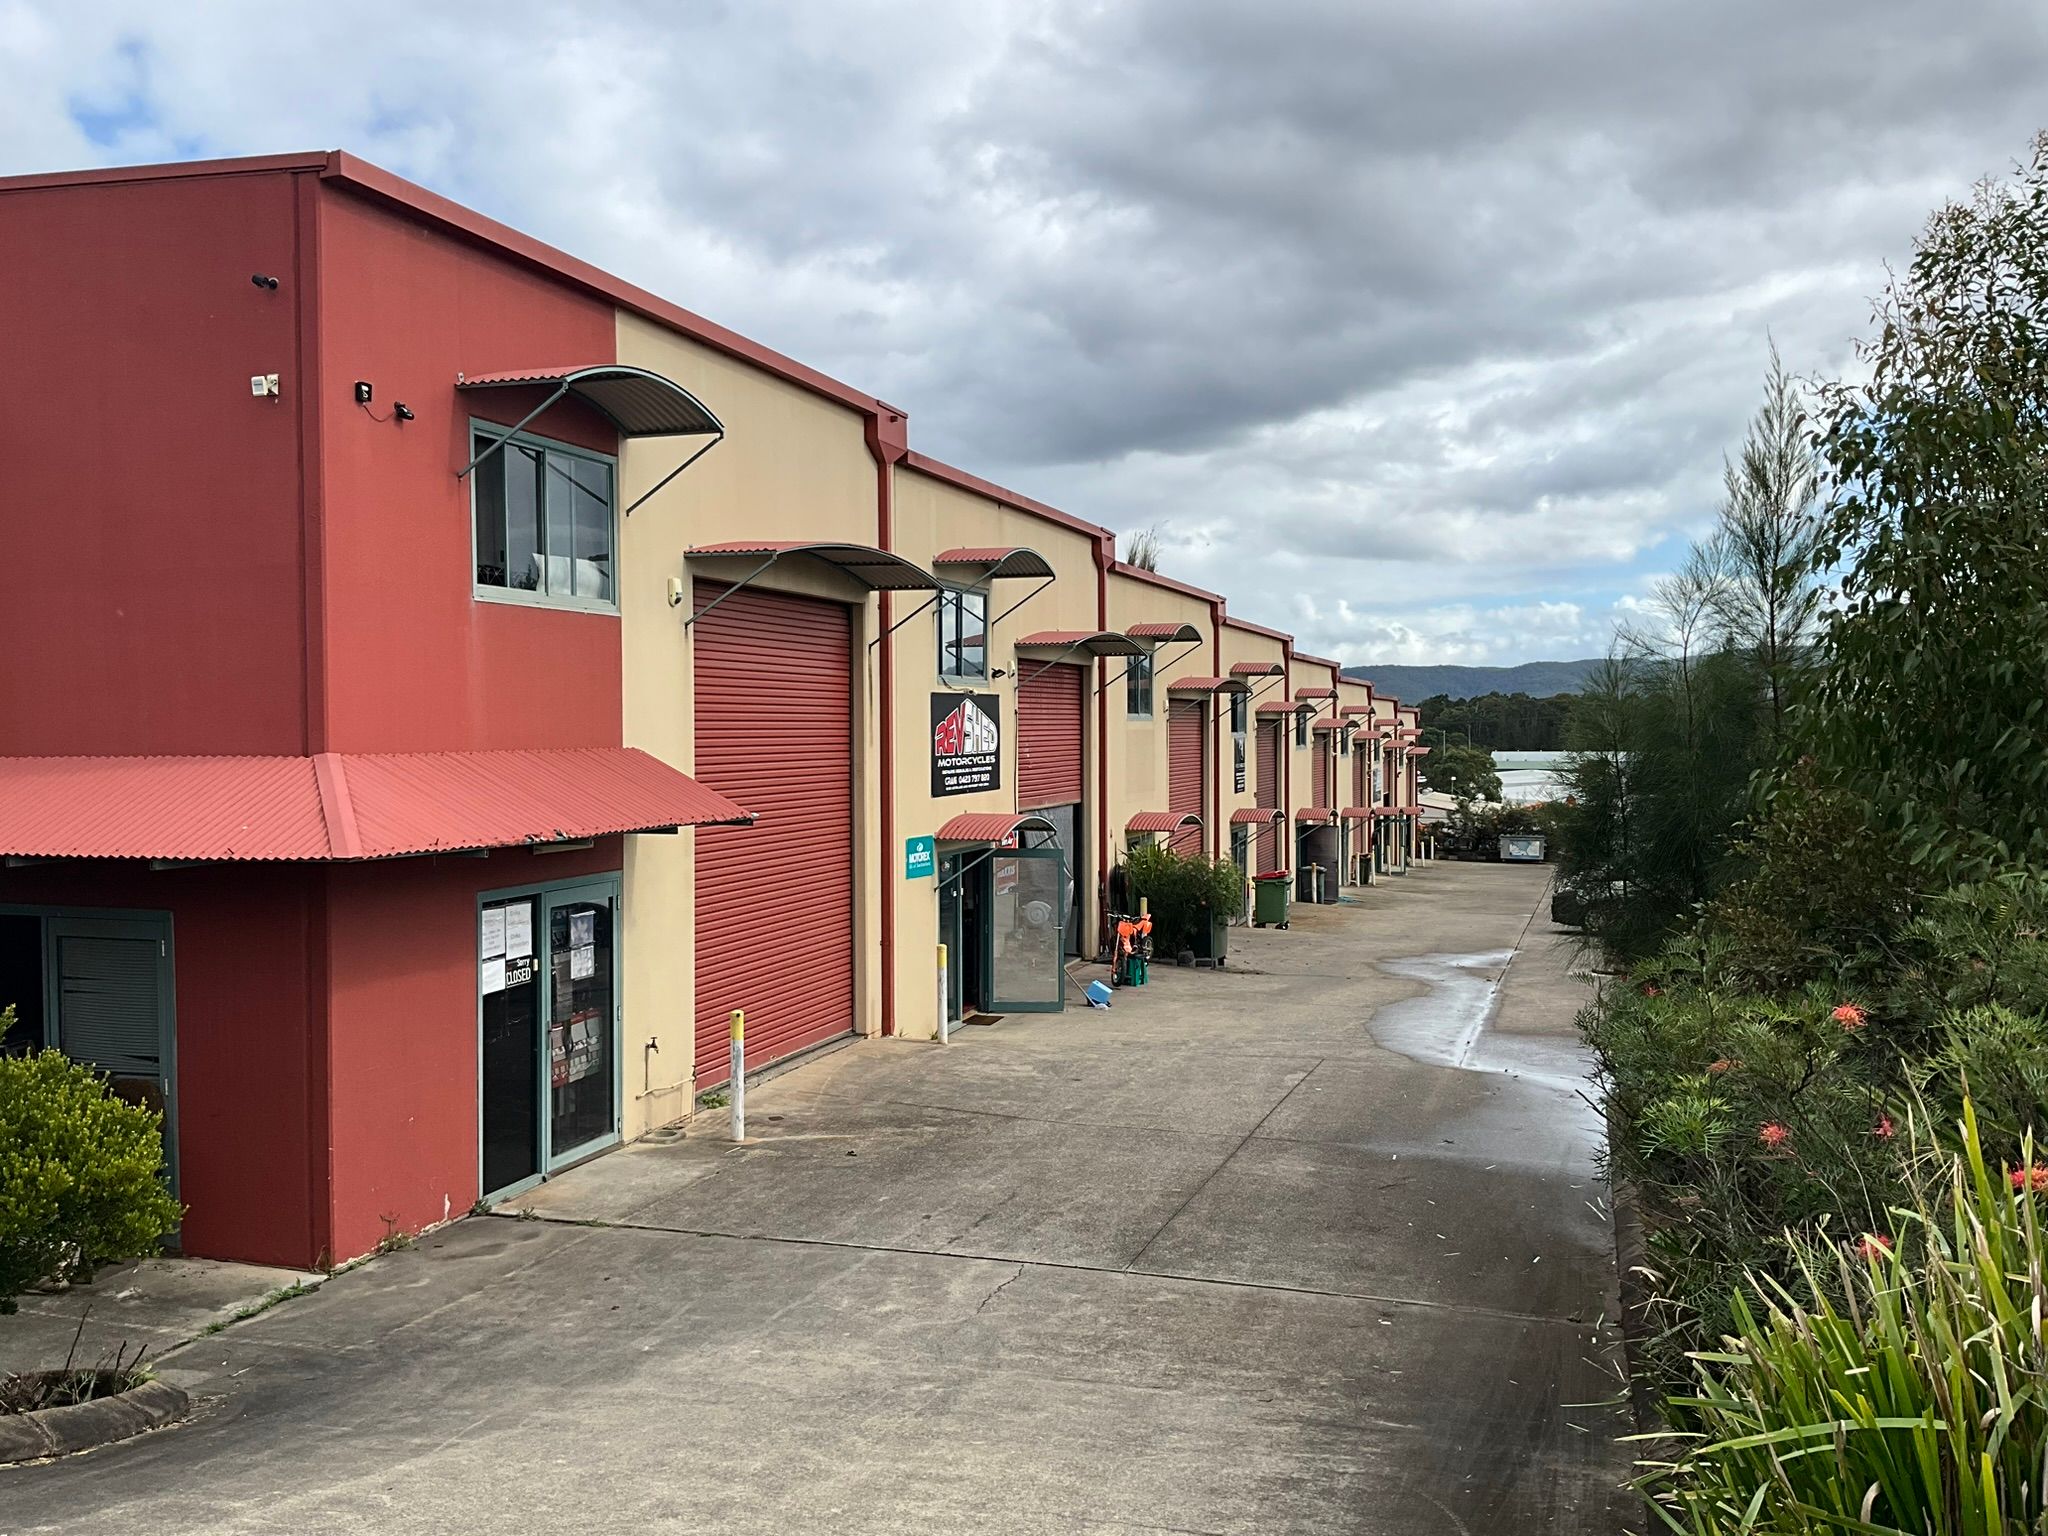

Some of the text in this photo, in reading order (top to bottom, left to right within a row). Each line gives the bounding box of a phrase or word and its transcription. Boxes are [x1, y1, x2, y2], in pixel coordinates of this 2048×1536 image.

[938, 755, 996, 767] MOTORCYCLES
[516, 958, 530, 967] Sorry
[506, 967, 531, 985] CLOSED
